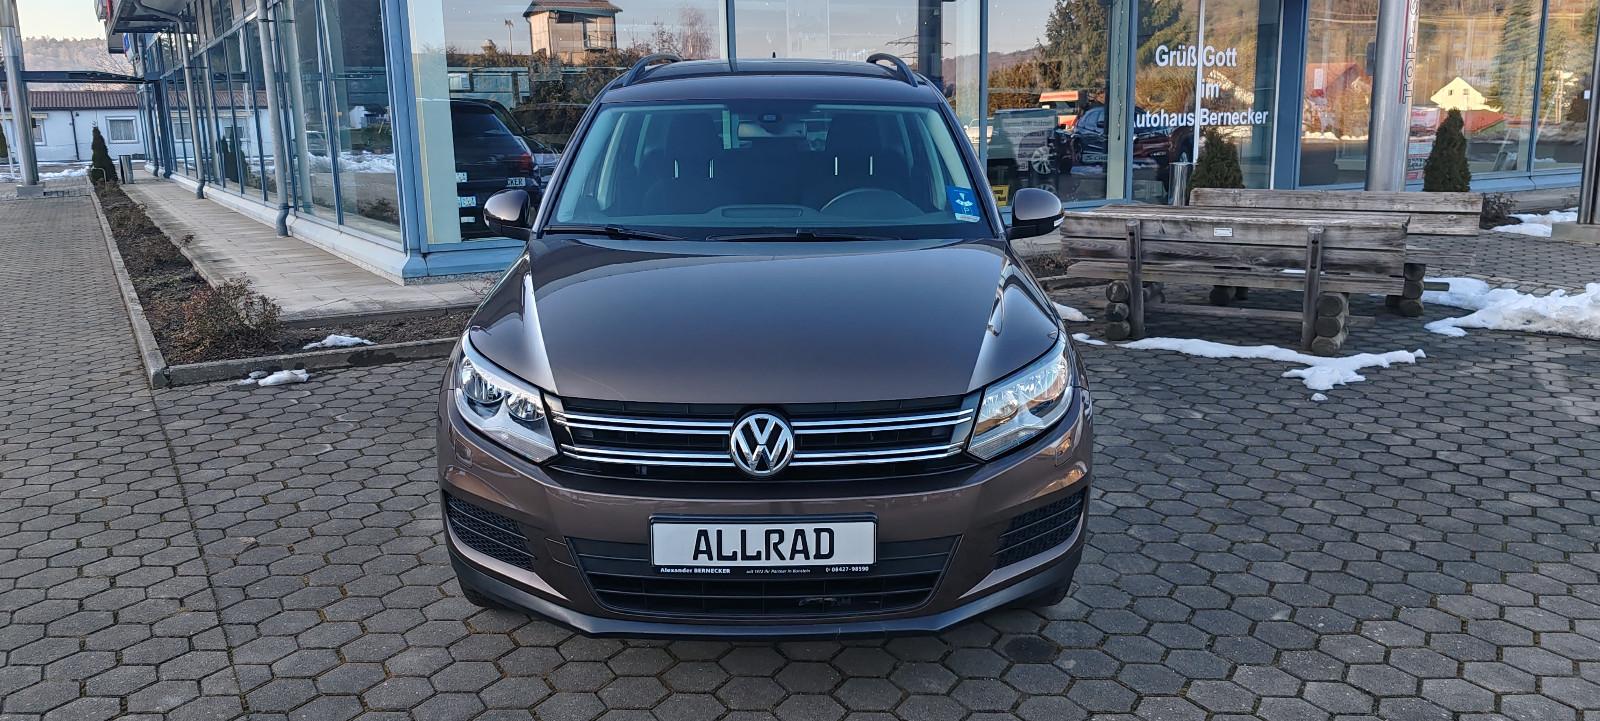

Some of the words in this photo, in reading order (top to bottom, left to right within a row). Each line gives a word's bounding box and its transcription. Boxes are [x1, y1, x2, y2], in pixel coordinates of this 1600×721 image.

[1155, 44, 1197, 67] Grüß
[1203, 45, 1237, 67] Gott
[1201, 78, 1219, 99] im
[1133, 108, 1195, 128] utohaus
[1200, 107, 1268, 126] Bernecker
[693, 527, 835, 561] ALLRAD
